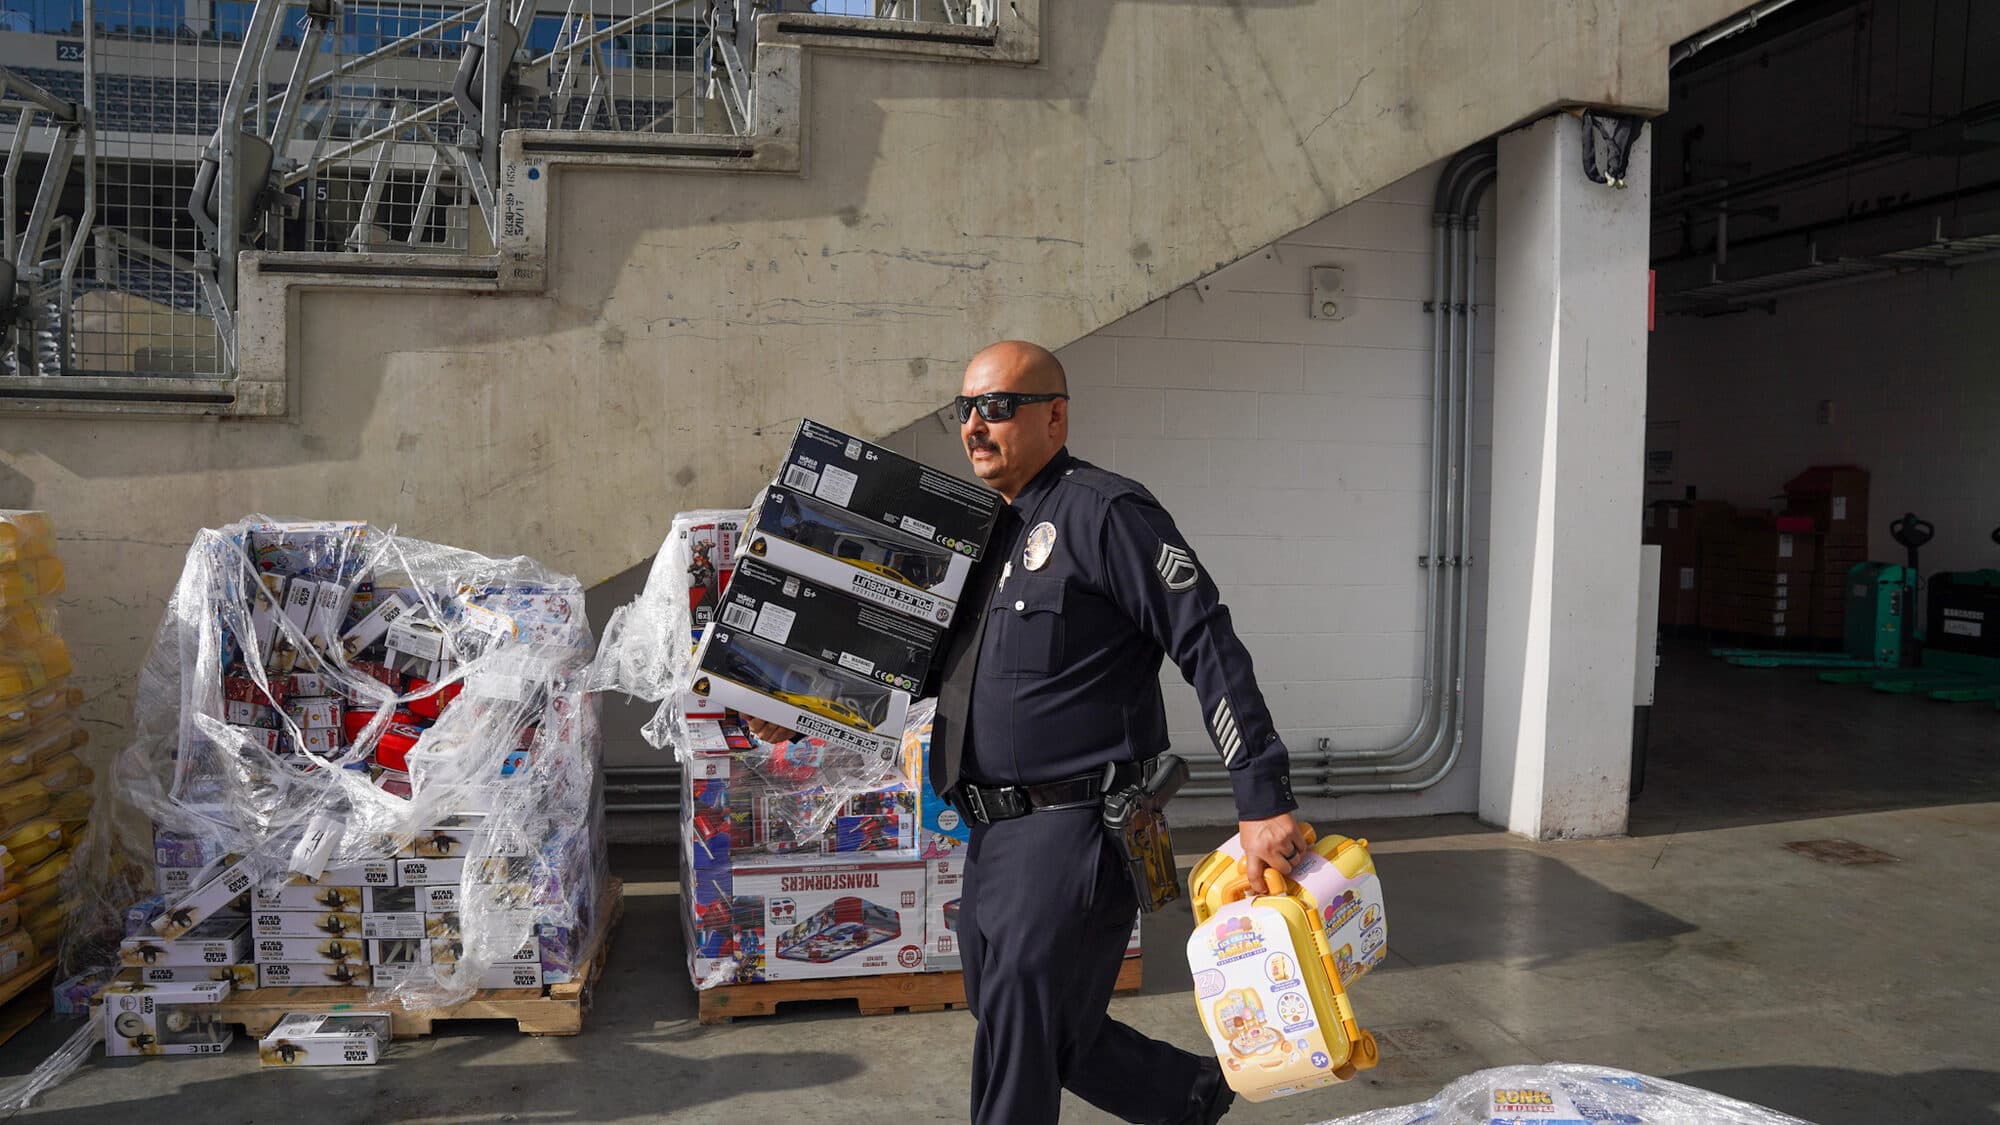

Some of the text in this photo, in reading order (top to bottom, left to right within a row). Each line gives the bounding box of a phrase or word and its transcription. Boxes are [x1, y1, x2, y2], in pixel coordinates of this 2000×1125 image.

[299, 186, 327, 200] 15
[865, 450, 879, 461] 6+
[803, 588, 817, 598] 6+
[854, 576, 898, 597] PURSUIT
[898, 591, 933, 611] POLICE
[798, 716, 842, 738] PURSUIT
[842, 733, 879, 752] POLICE
[781, 873, 879, 892] TRANSFORMERS
[1312, 1055, 1327, 1066] 3+
[1494, 1088, 1554, 1105] SONIC
